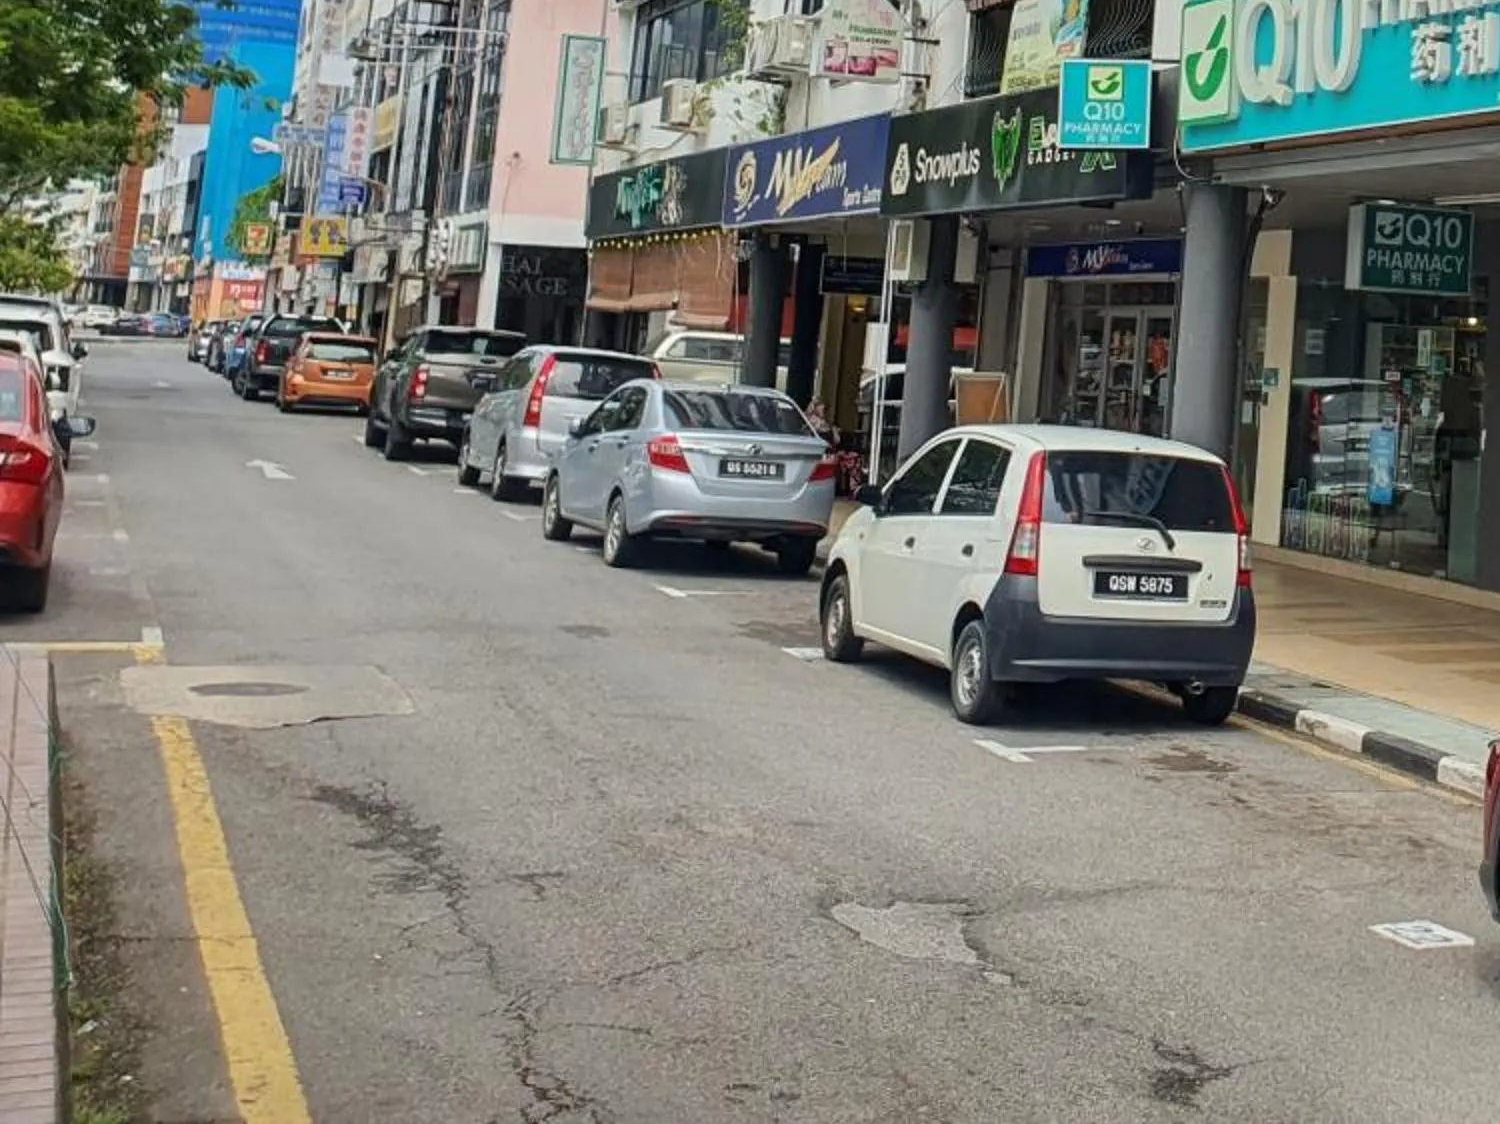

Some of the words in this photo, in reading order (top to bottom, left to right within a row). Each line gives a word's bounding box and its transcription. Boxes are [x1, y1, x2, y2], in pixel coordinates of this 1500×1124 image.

[1083, 101, 1125, 121] Q10
[1064, 122, 1142, 135] PHARMACY
[915, 140, 980, 187] Snowplus
[1405, 213, 1463, 249] Q10
[1367, 247, 1465, 275] PHARMACY
